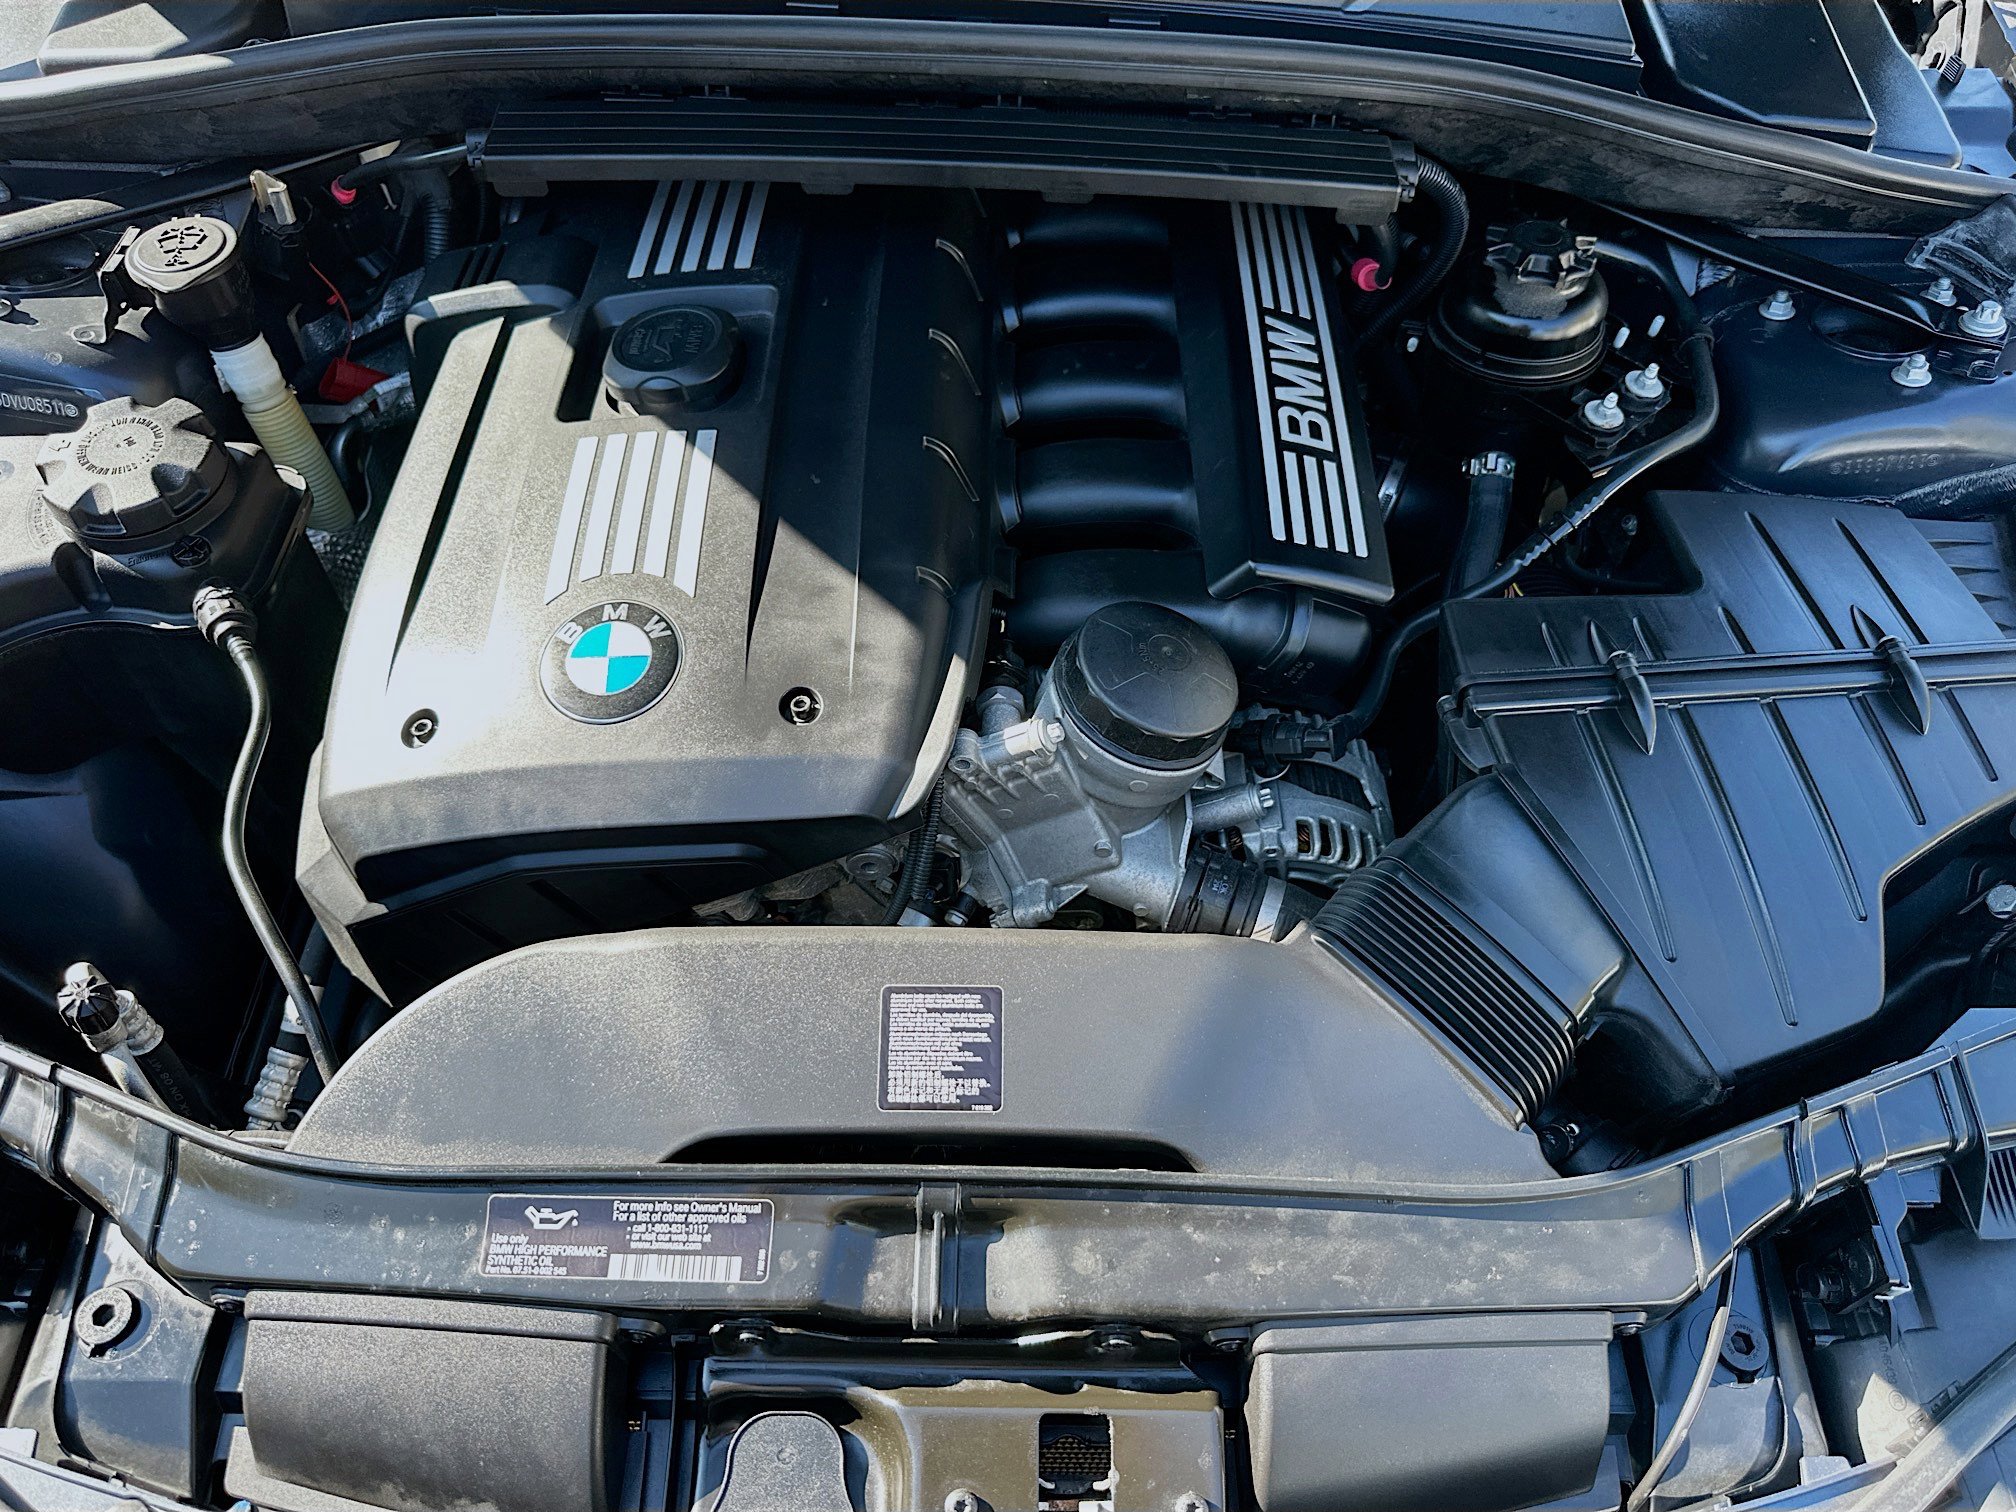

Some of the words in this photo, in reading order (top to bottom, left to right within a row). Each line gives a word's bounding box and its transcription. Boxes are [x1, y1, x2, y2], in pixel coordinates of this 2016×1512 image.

[1265, 315, 1334, 452] BMW
[555, 603, 673, 645] BMW
[613, 1201, 629, 1211] For
[630, 1202, 654, 1212] more
[673, 1204, 689, 1212] see
[690, 1202, 727, 1213] Owner's
[728, 1203, 762, 1214] Manual
[612, 1211, 629, 1222] For
[629, 1214, 636, 1222] a
[637, 1212, 651, 1222] list
[651, 1212, 662, 1222] of
[662, 1212, 687, 1222] other
[687, 1213, 730, 1224] approved
[731, 1214, 747, 1224] oils
[632, 1224, 647, 1233] call
[491, 1233, 508, 1244] Use
[509, 1233, 529, 1246] only
[631, 1233, 641, 1241] or
[657, 1233, 670, 1241] our
[489, 1243, 514, 1255] BMW
[514, 1244, 538, 1256] HIGH
[538, 1244, 608, 1257] PERFORMANCE
[487, 1254, 538, 1266] SYNTHETIC
[538, 1256, 554, 1266] OIL
